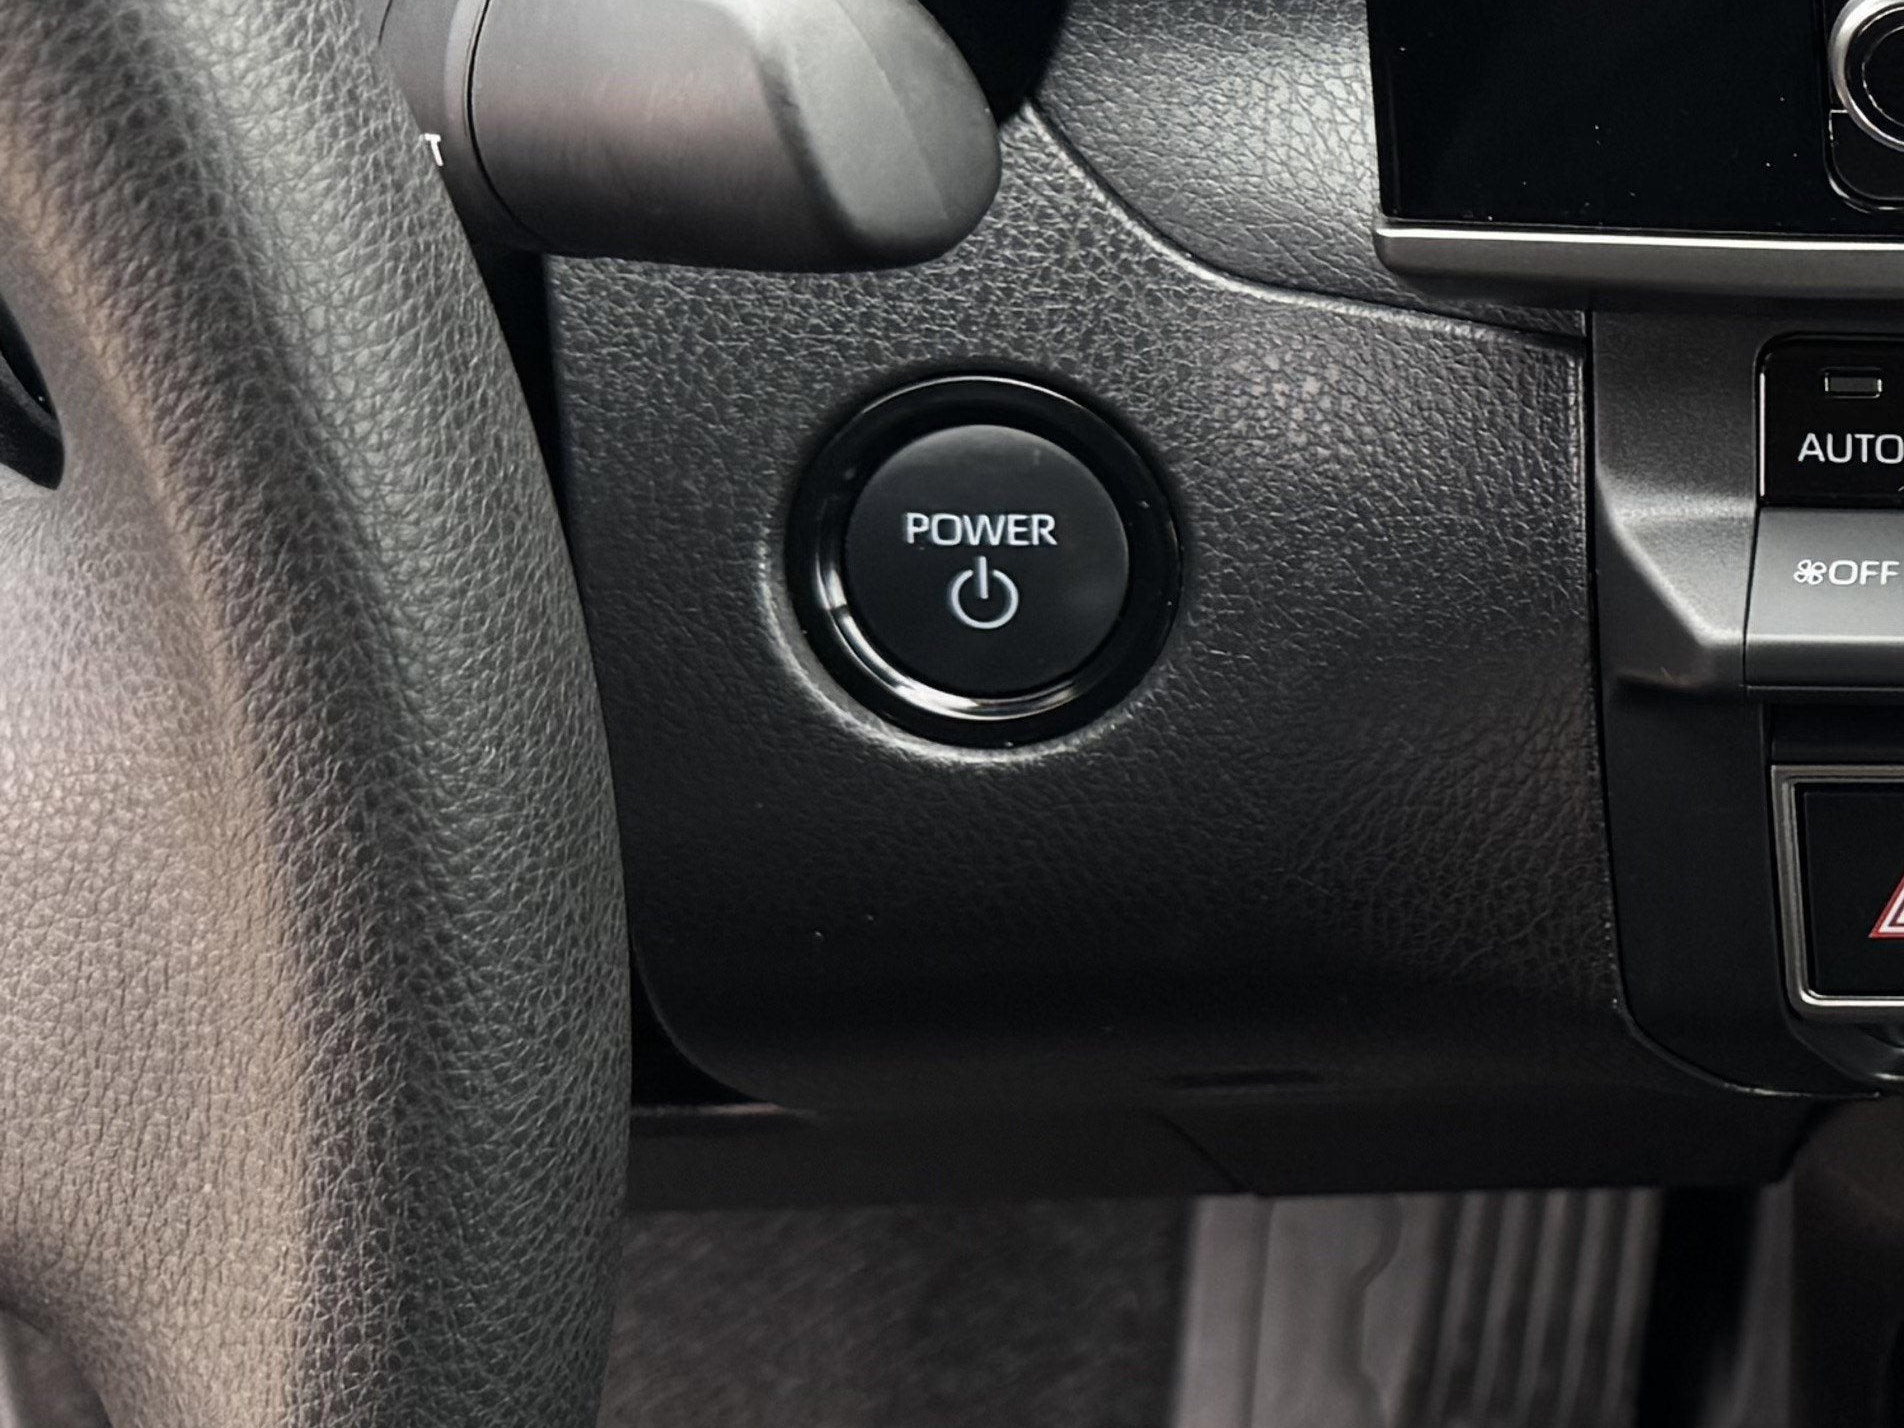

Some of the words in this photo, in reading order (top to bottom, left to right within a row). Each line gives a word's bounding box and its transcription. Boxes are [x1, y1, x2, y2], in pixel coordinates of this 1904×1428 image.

[1797, 432, 1904, 464] AUTO
[906, 512, 1058, 546] POWER
[1828, 560, 1900, 585] OFF
